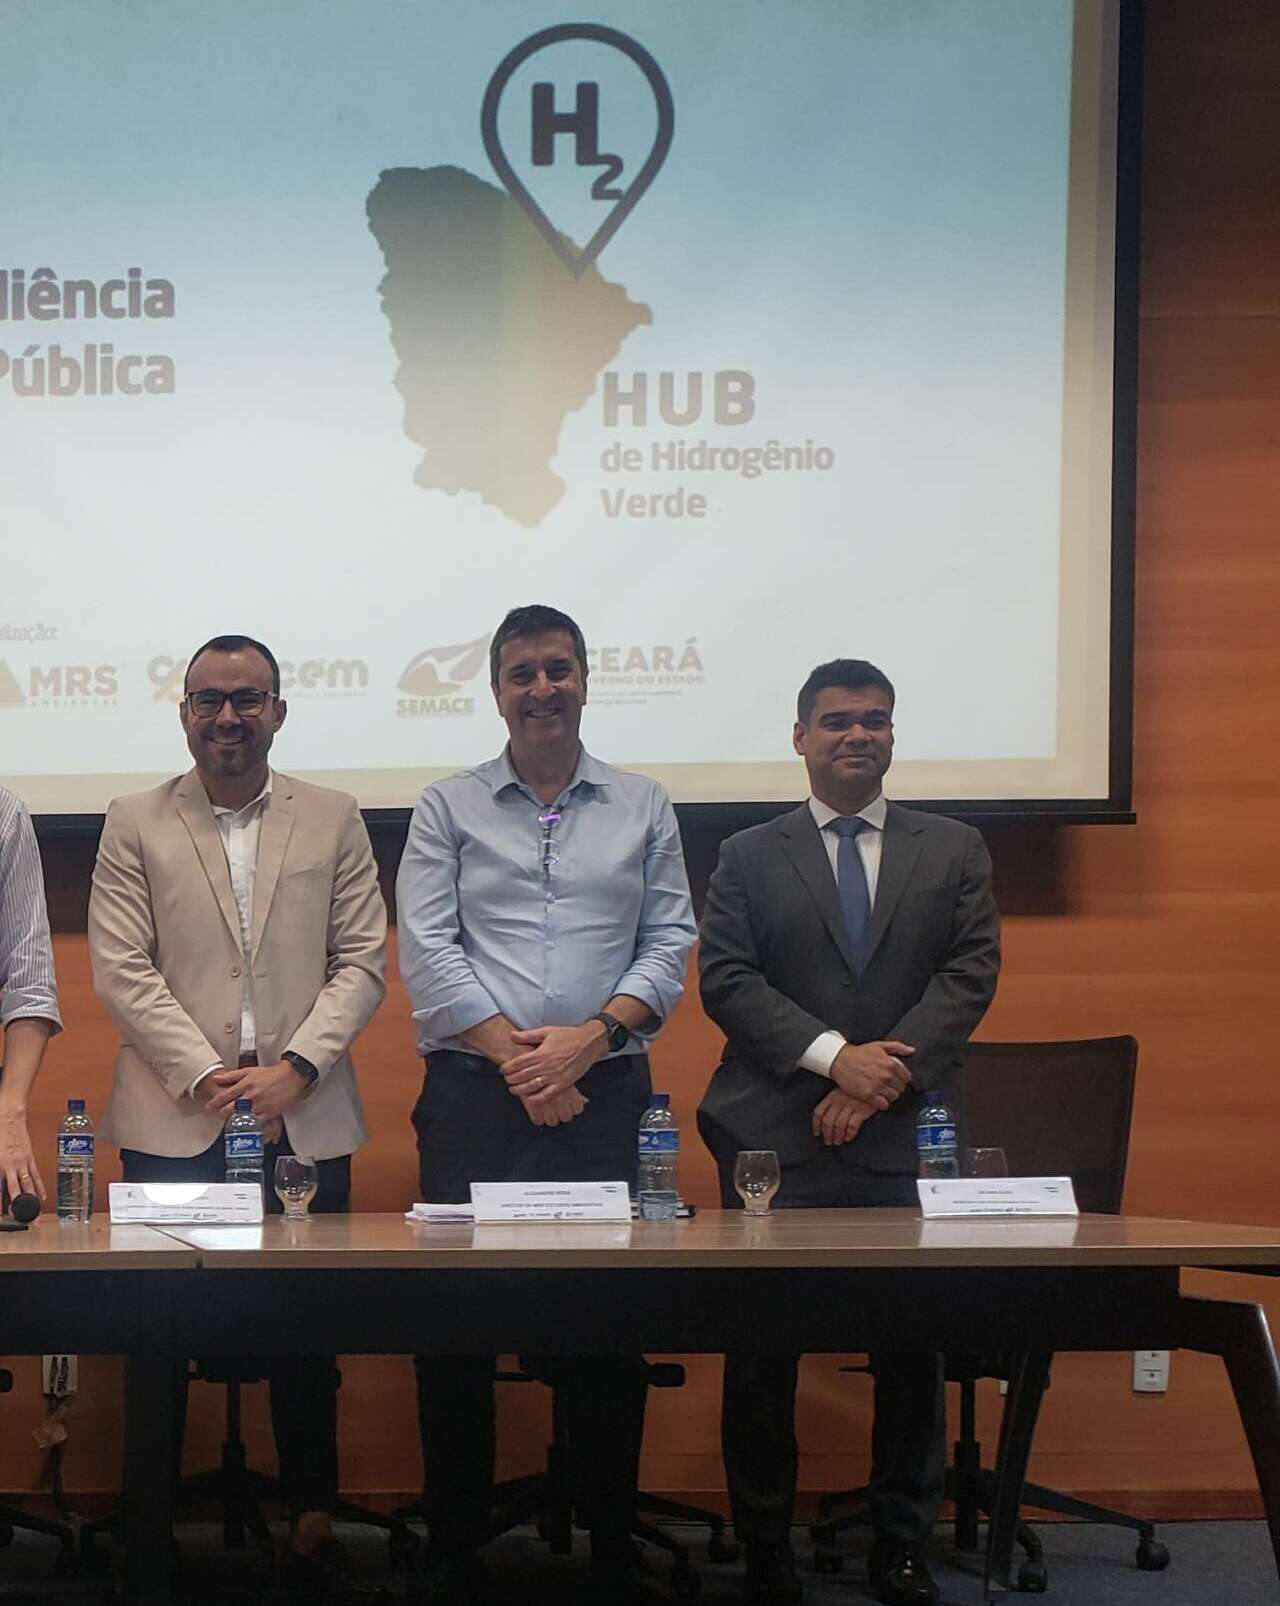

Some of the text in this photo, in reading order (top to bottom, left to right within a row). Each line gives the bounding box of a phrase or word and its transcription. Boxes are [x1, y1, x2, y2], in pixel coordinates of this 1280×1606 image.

[603, 370, 756, 426] HUB
[600, 440, 834, 477] de Hidrogênio
[600, 486, 707, 518] Verde
[29, 665, 118, 696] MRS
[397, 698, 474, 713] SEMACE
